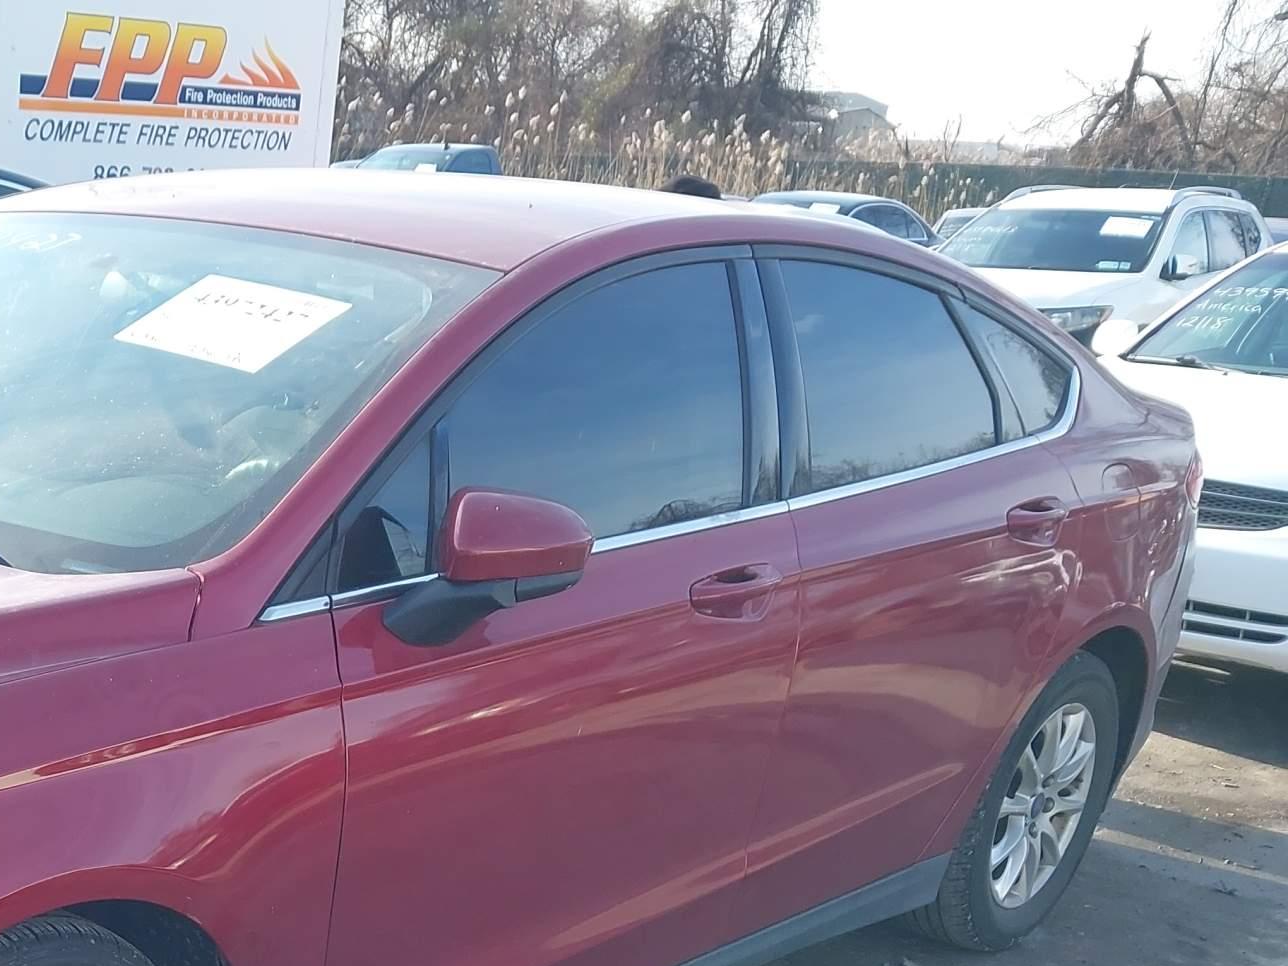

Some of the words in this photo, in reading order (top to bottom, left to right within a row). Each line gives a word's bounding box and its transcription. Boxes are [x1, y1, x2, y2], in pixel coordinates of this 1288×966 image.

[41, 11, 228, 105] FPP
[185, 87, 204, 102] Fire
[207, 89, 254, 106] Protection
[257, 92, 297, 109] Products
[24, 118, 130, 145] COMPLETE
[136, 123, 179, 147] FIRE
[184, 126, 292, 151] PROTECTION
